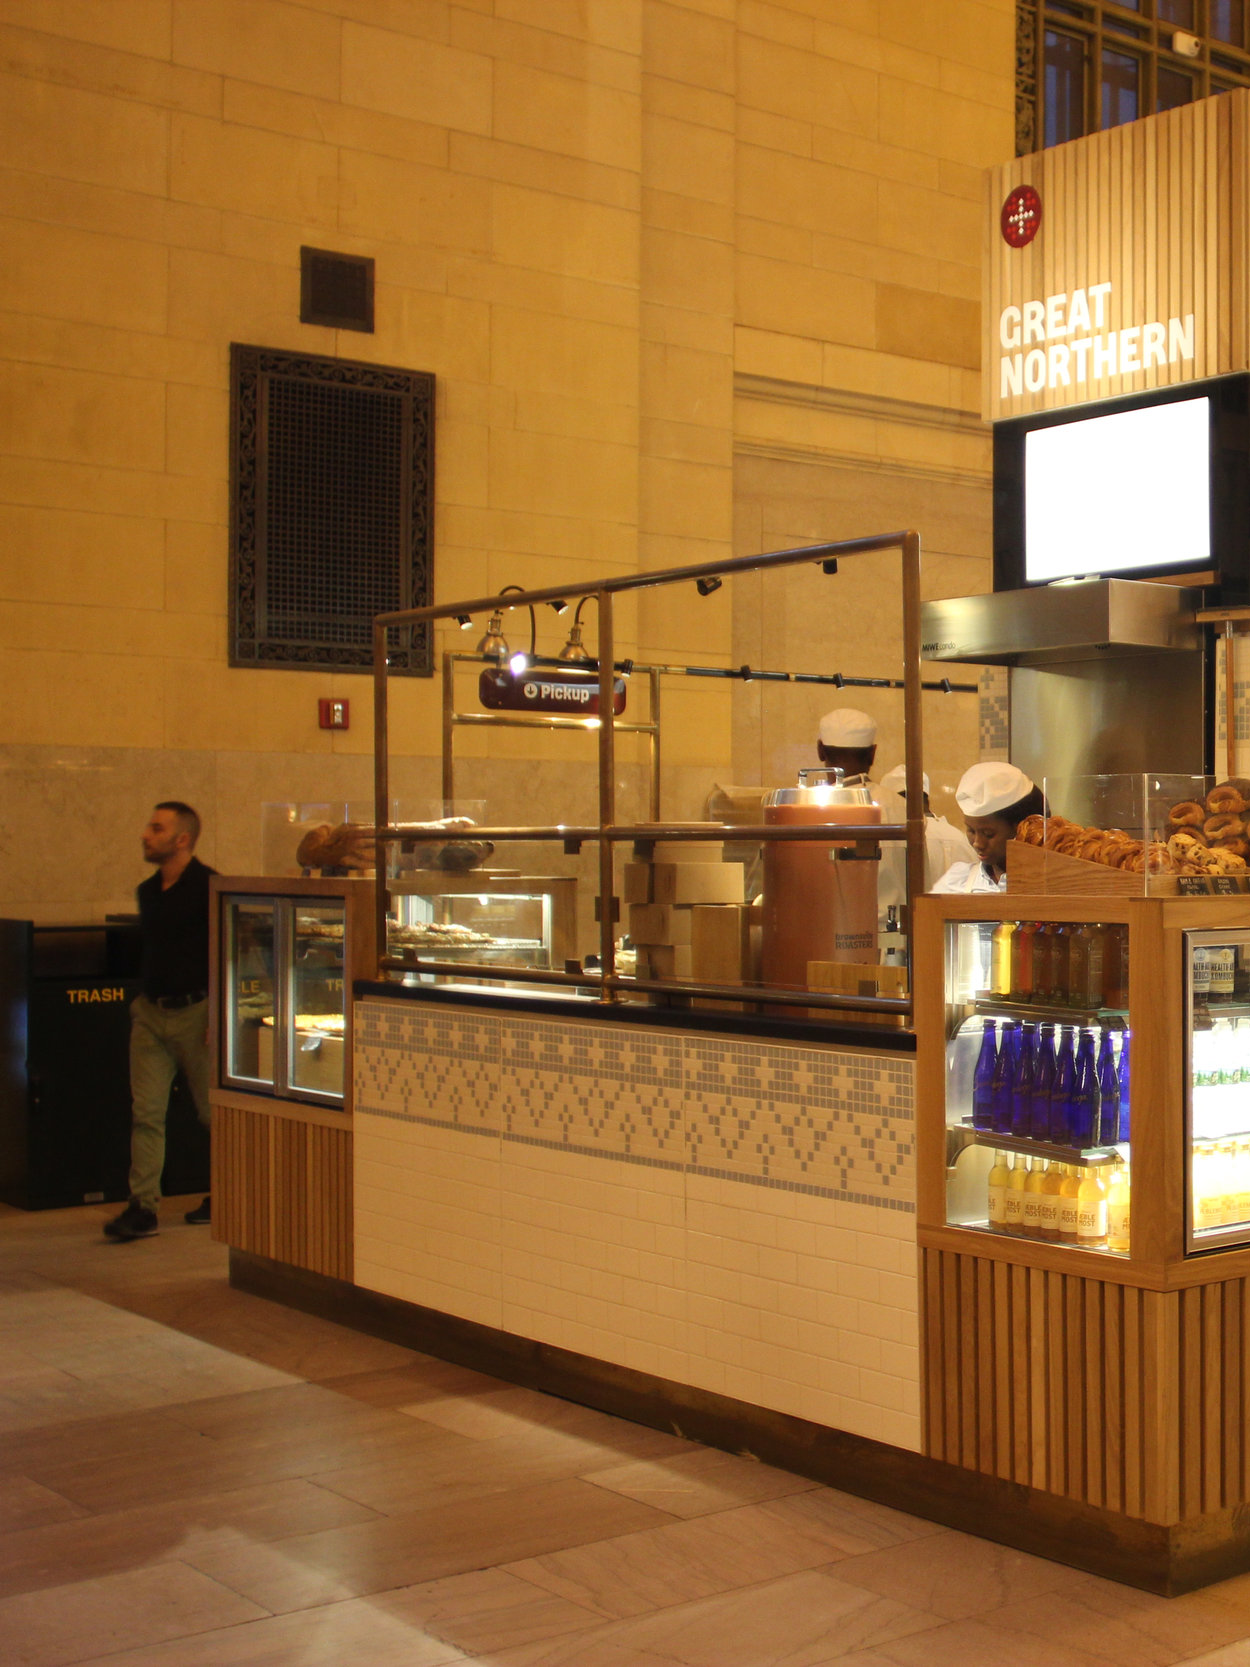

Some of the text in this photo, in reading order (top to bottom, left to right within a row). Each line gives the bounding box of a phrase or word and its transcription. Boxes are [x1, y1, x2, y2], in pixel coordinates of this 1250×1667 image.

[1000, 282, 1112, 348] GREAT
[1000, 314, 1194, 398] NORTHERN
[541, 685, 590, 704] Pickup
[66, 988, 124, 1004] TRASH
